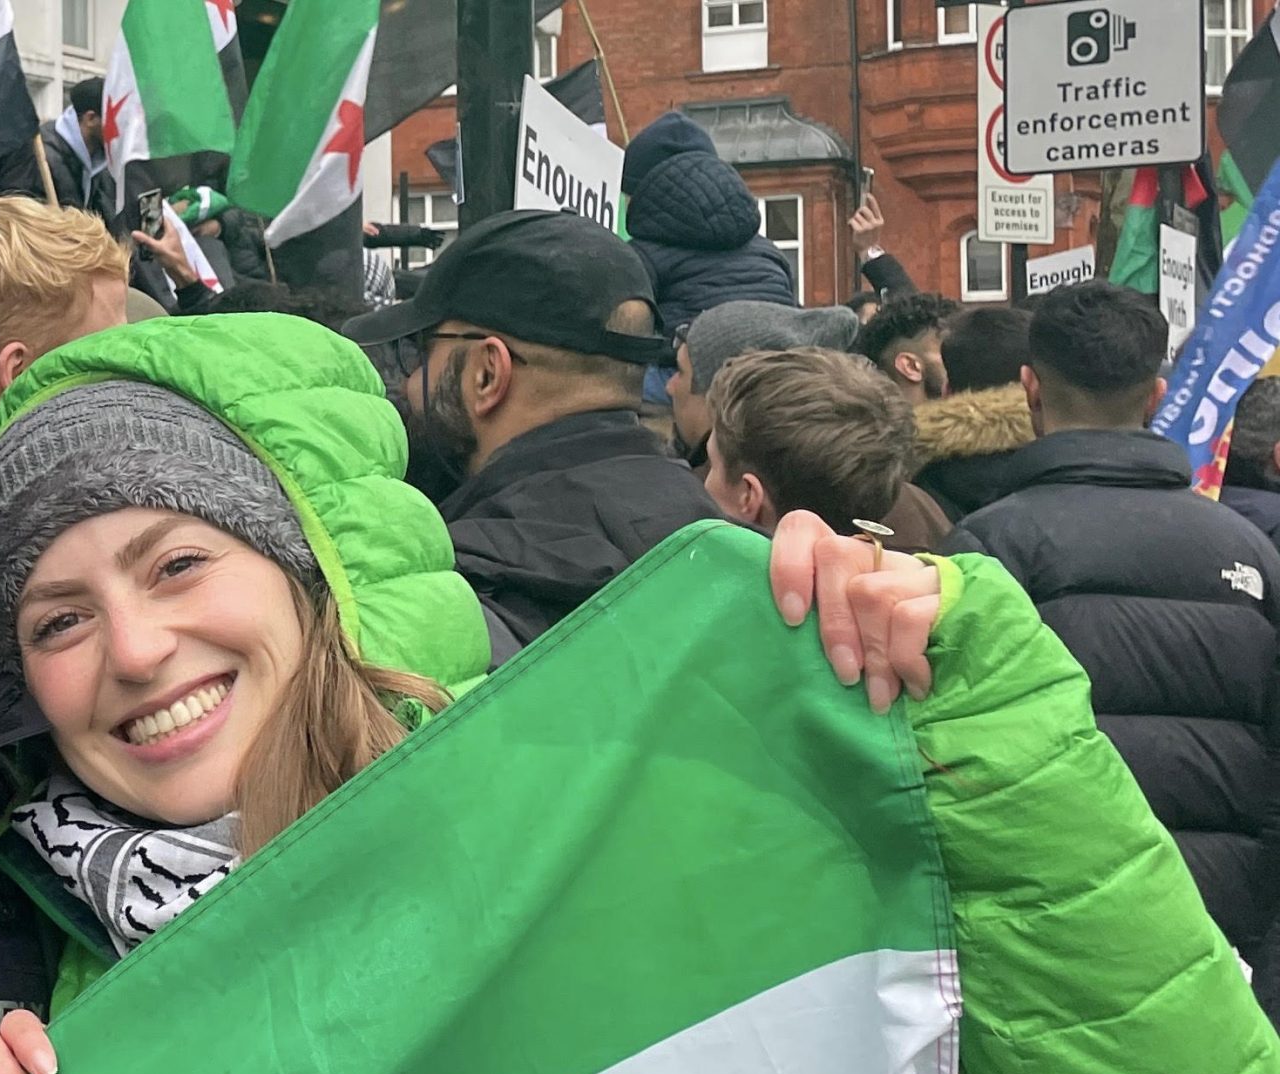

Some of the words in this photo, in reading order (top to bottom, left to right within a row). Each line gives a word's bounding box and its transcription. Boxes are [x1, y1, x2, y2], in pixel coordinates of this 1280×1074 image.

[1057, 77, 1147, 103] Traffic
[1017, 101, 1191, 136] enforcement
[1046, 138, 1160, 162] cameras
[991, 191, 1024, 204] Except
[1028, 193, 1042, 204] for
[994, 207, 1027, 218] access
[1030, 208, 1040, 218] to
[994, 221, 1039, 232] premises
[1162, 248, 1194, 290] Enough
